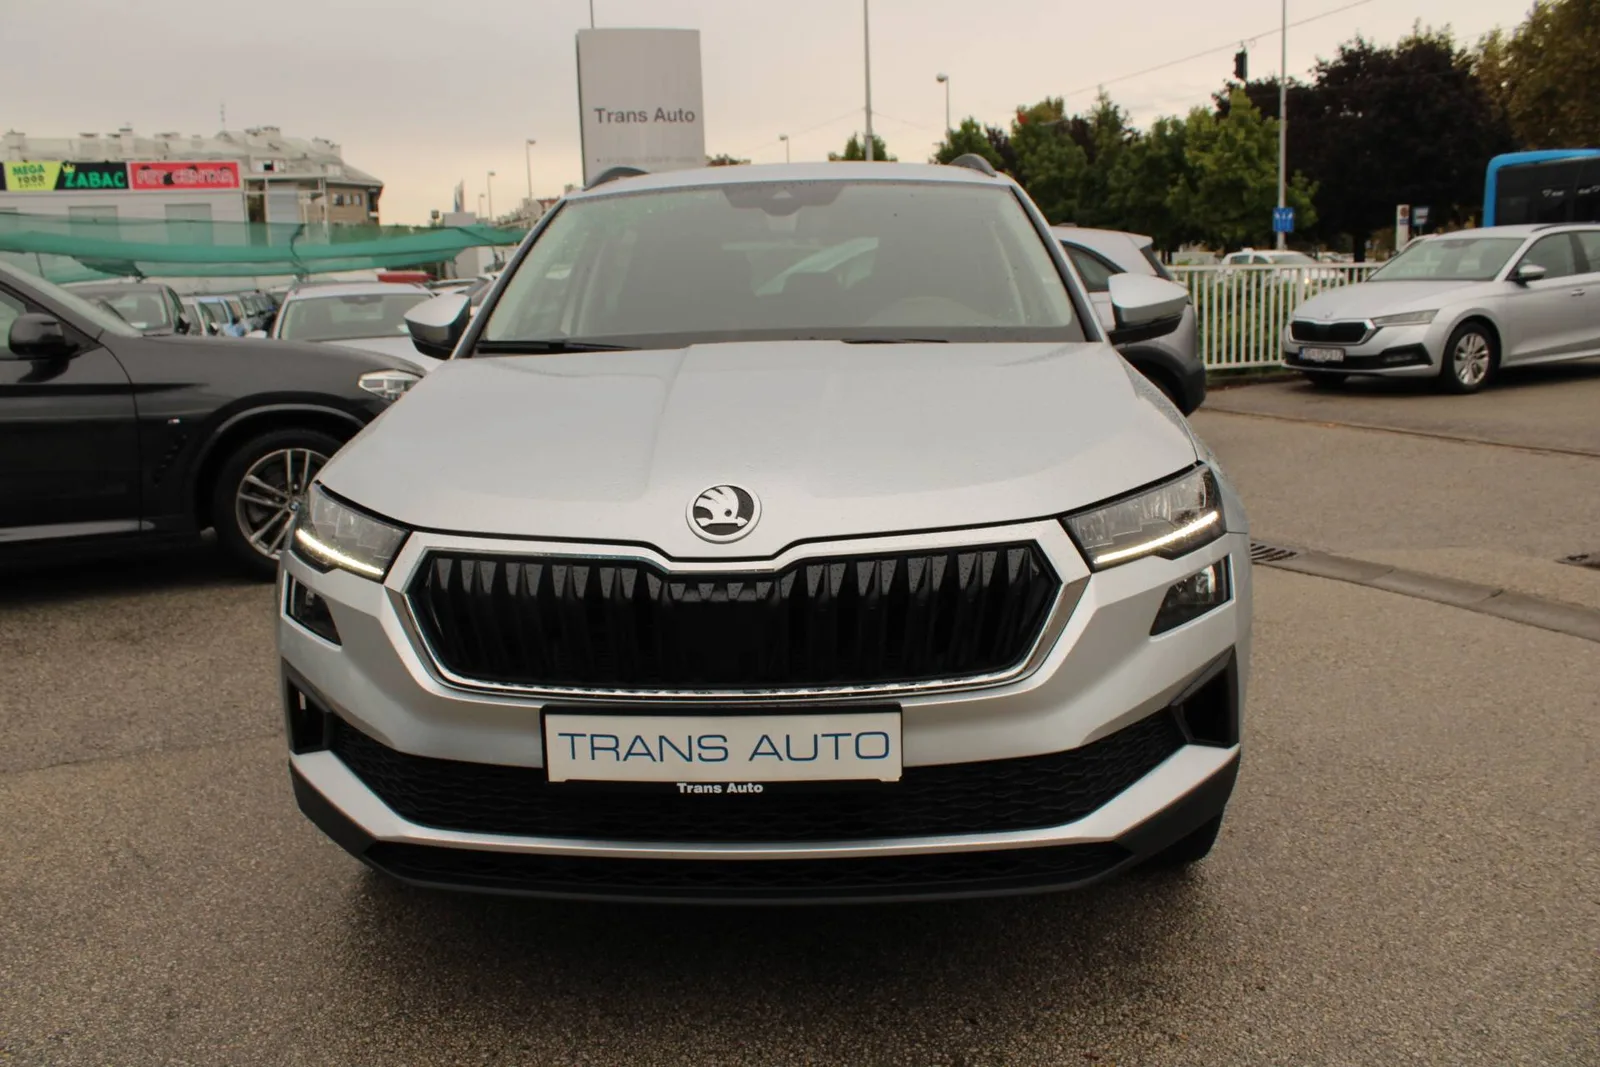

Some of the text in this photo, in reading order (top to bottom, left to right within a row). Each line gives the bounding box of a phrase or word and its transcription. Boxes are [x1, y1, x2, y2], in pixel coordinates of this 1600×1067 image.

[593, 107, 695, 123] Trans Auto
[12, 164, 45, 175] MEGA
[557, 731, 891, 763] TRANS AUTO
[676, 782, 764, 794] Trans Auto
